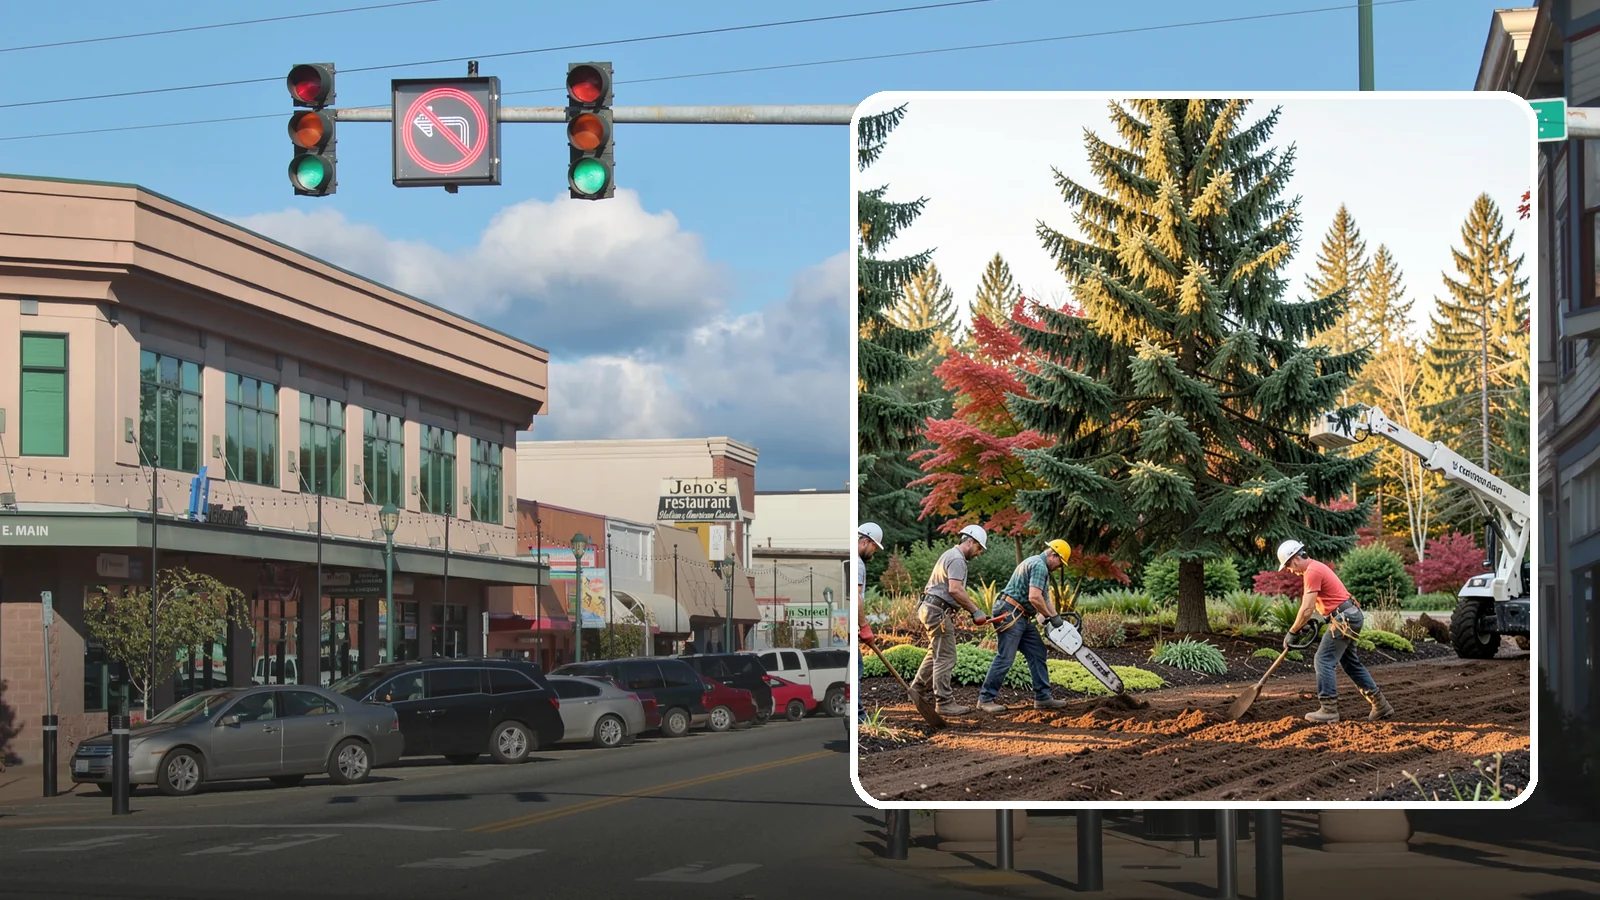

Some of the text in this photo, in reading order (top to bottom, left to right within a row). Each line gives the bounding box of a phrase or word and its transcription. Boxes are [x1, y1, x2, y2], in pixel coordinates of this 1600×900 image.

[670, 480, 728, 495] Jeno's
[665, 496, 731, 509] restaurant
[658, 510, 682, 520] Italian
[686, 510, 715, 519] American
[715, 510, 738, 519] Cuisine
[2, 525, 49, 536] E. MAIN
[786, 607, 794, 616] in
[797, 607, 828, 616] Street
[790, 619, 824, 627] lass
